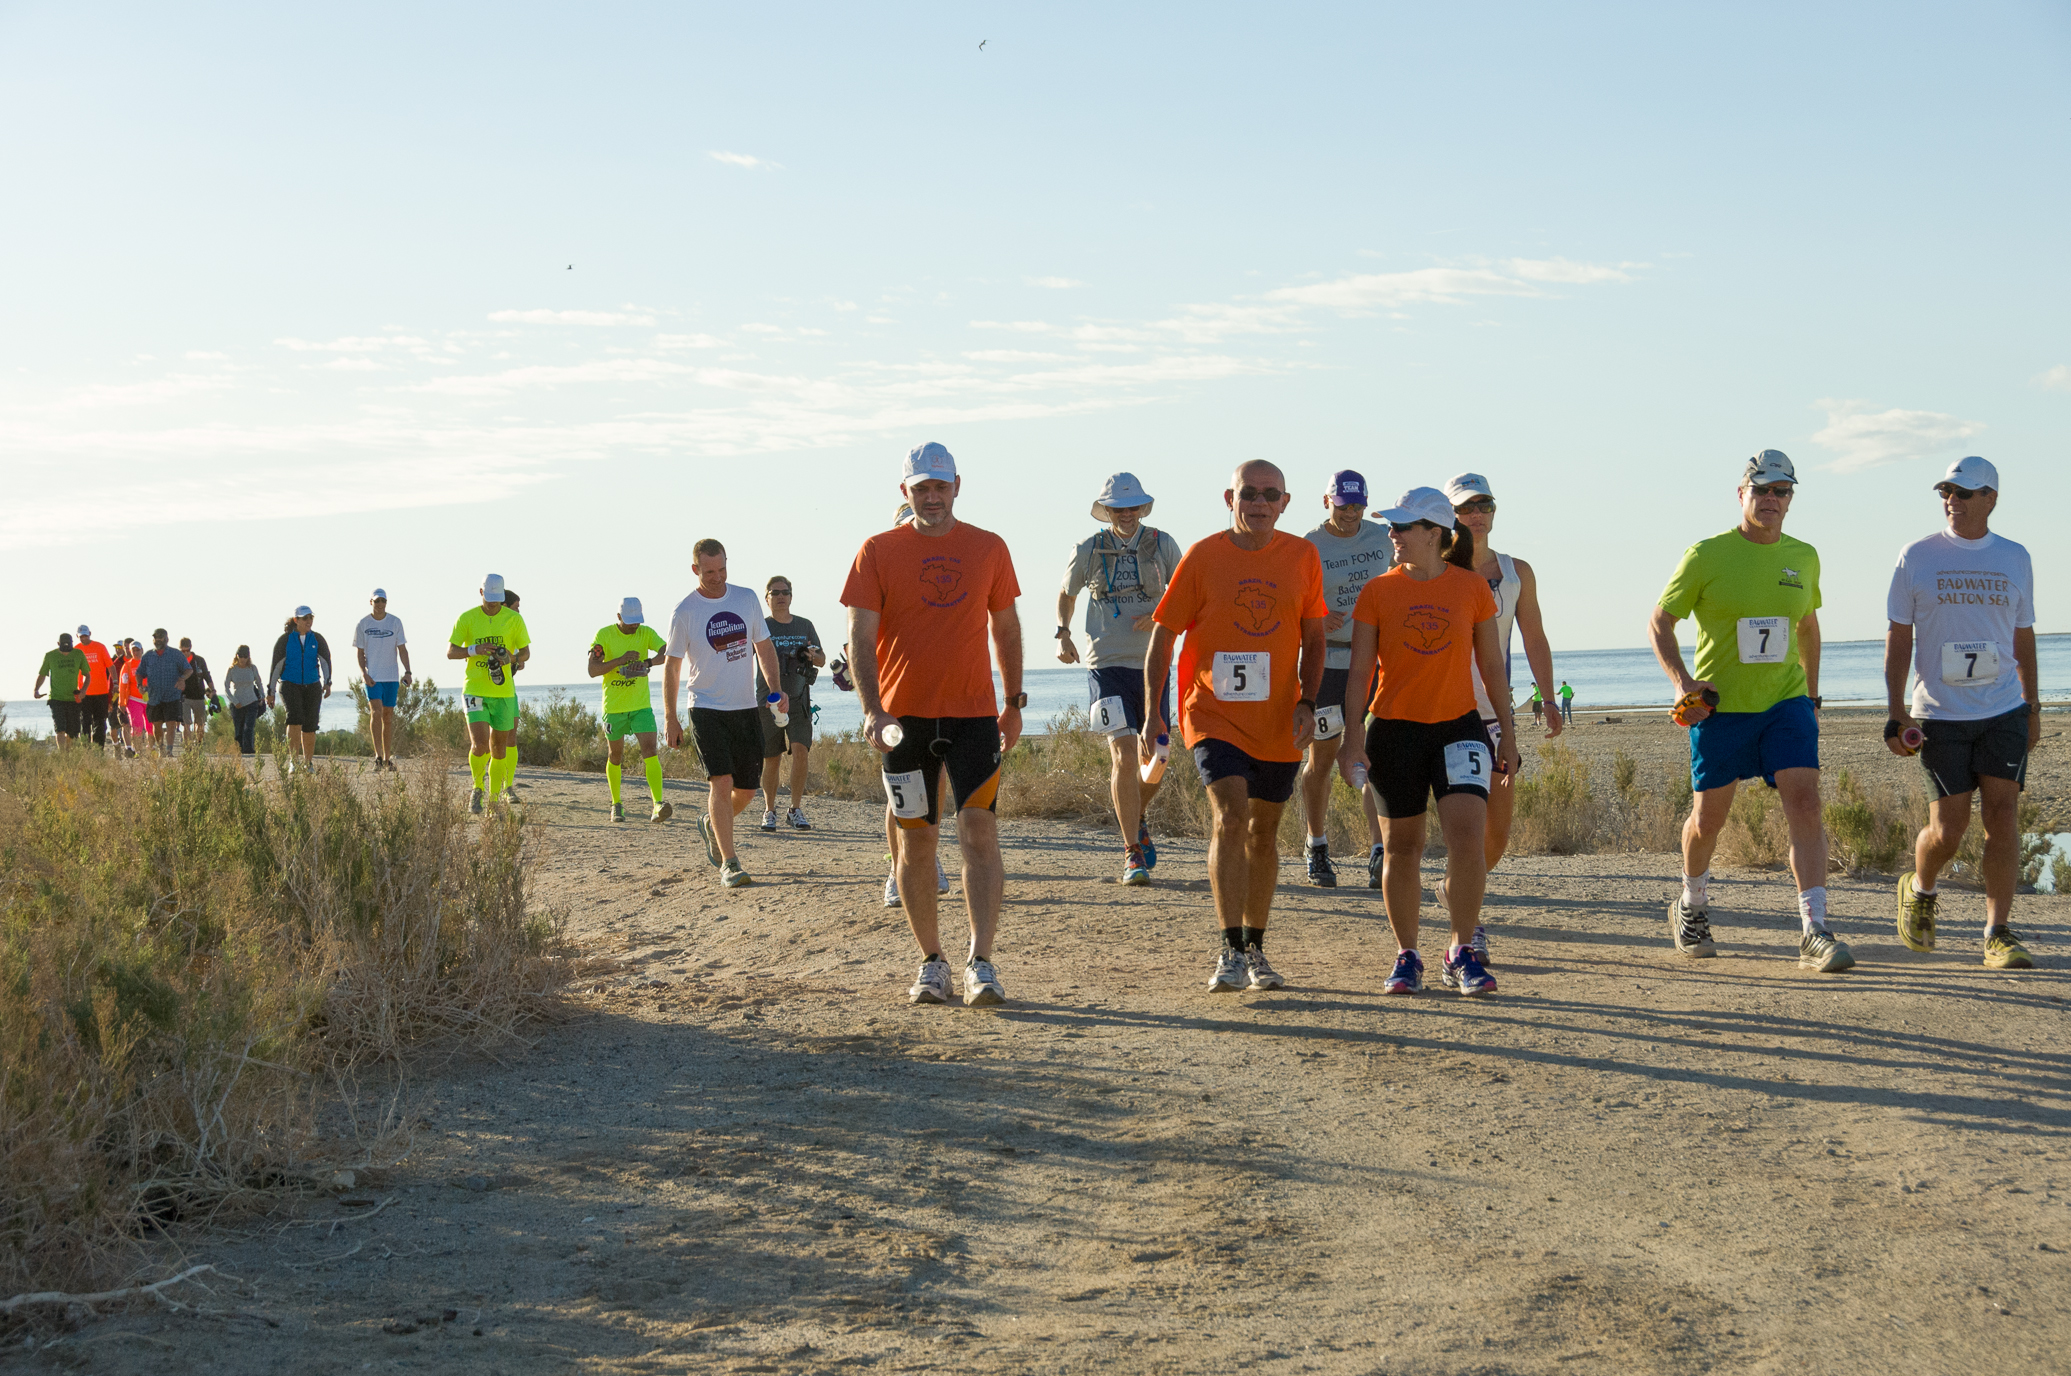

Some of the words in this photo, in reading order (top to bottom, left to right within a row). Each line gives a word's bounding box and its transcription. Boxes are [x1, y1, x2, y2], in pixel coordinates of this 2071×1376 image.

[1324, 558, 1349, 571] Team
[1351, 549, 1384, 565] FOMO
[936, 574, 952, 584] 135
[1116, 570, 1138, 581] 2013
[1348, 569, 1370, 583] 2013
[1338, 583, 1364, 596] Badw
[1937, 578, 2009, 593] BADWATER
[1250, 600, 1267, 609] 135
[1336, 595, 1358, 608] Salto
[1937, 592, 1984, 606] SALTON
[1988, 593, 2010, 607] SEA
[710, 620, 728, 629] Team
[1421, 622, 1439, 630] 135
[1748, 618, 1778, 626] BADWATER
[708, 622, 745, 637] Neapolitan
[475, 636, 504, 646] SALTON
[1758, 628, 1770, 654] 7
[1953, 642, 1987, 651] BADWATER
[1964, 652, 1978, 678] 7
[1233, 664, 1246, 692] 5
[464, 696, 477, 708] 14
[1100, 707, 1110, 727] 8
[1317, 716, 1329, 734] 8
[1468, 750, 1481, 775] 5
[891, 784, 905, 809] 5
